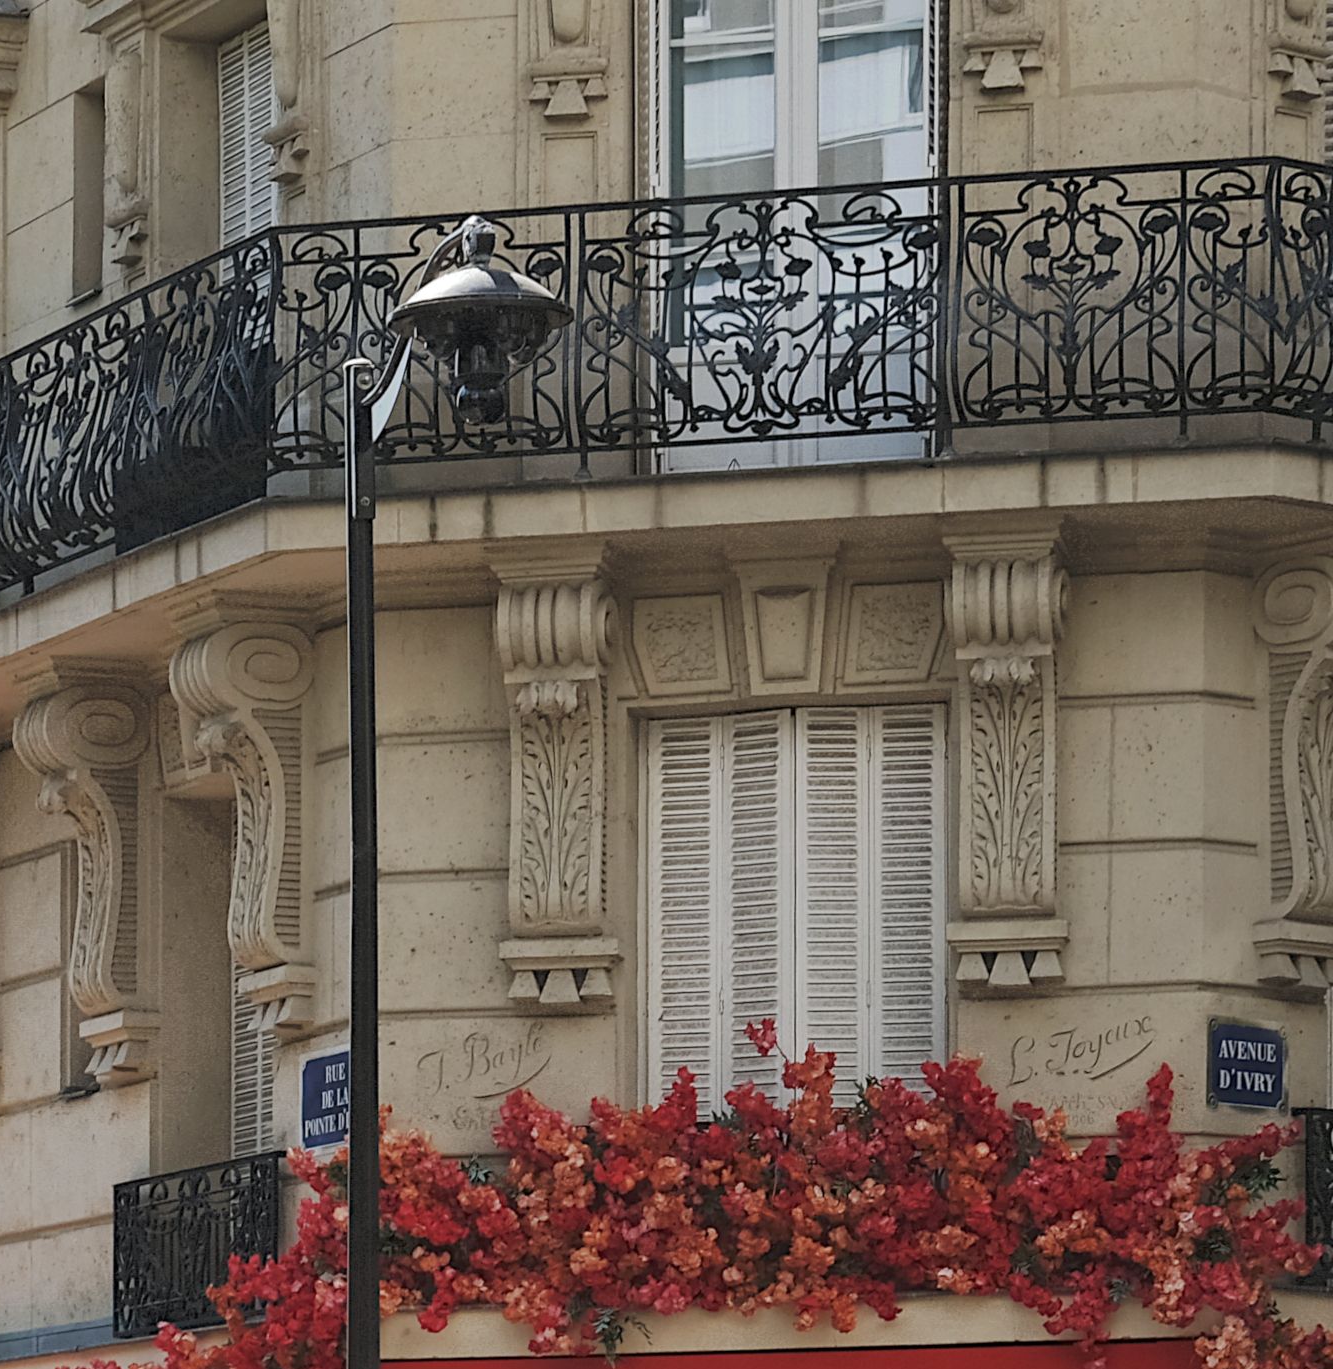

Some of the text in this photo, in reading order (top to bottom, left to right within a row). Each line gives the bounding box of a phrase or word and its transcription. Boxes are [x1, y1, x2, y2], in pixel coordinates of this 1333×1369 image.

[1218, 1039, 1277, 1063] AVENUE
[325, 1061, 346, 1084] RUE
[1219, 1067, 1277, 1094] D'IVRY
[321, 1086, 349, 1109] DE LA
[304, 1112, 336, 1139] POINTE
